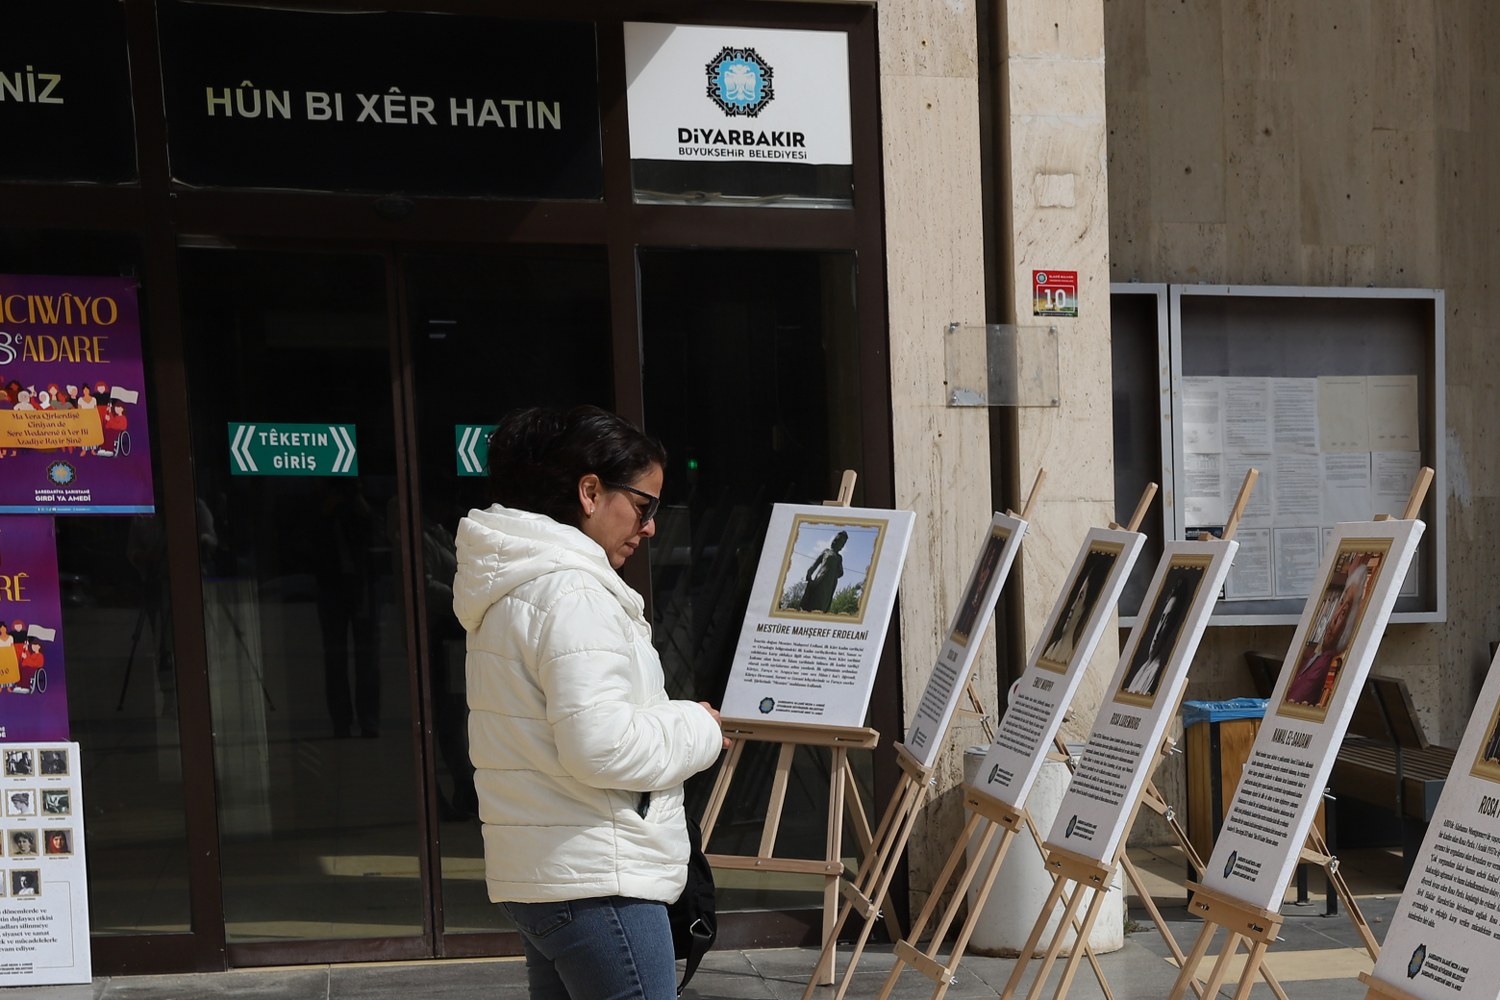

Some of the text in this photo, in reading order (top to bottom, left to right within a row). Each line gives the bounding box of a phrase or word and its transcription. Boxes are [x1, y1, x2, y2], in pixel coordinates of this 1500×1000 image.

[206, 80, 562, 131] HÛN BI XÊR HATIN
[1044, 289, 1066, 309] 10
[22, 335, 111, 363] ADARE
[259, 428, 328, 447] TÊKETIN
[273, 452, 317, 471] GİRİŞ
[1478, 796, 1500, 818] ROSA
